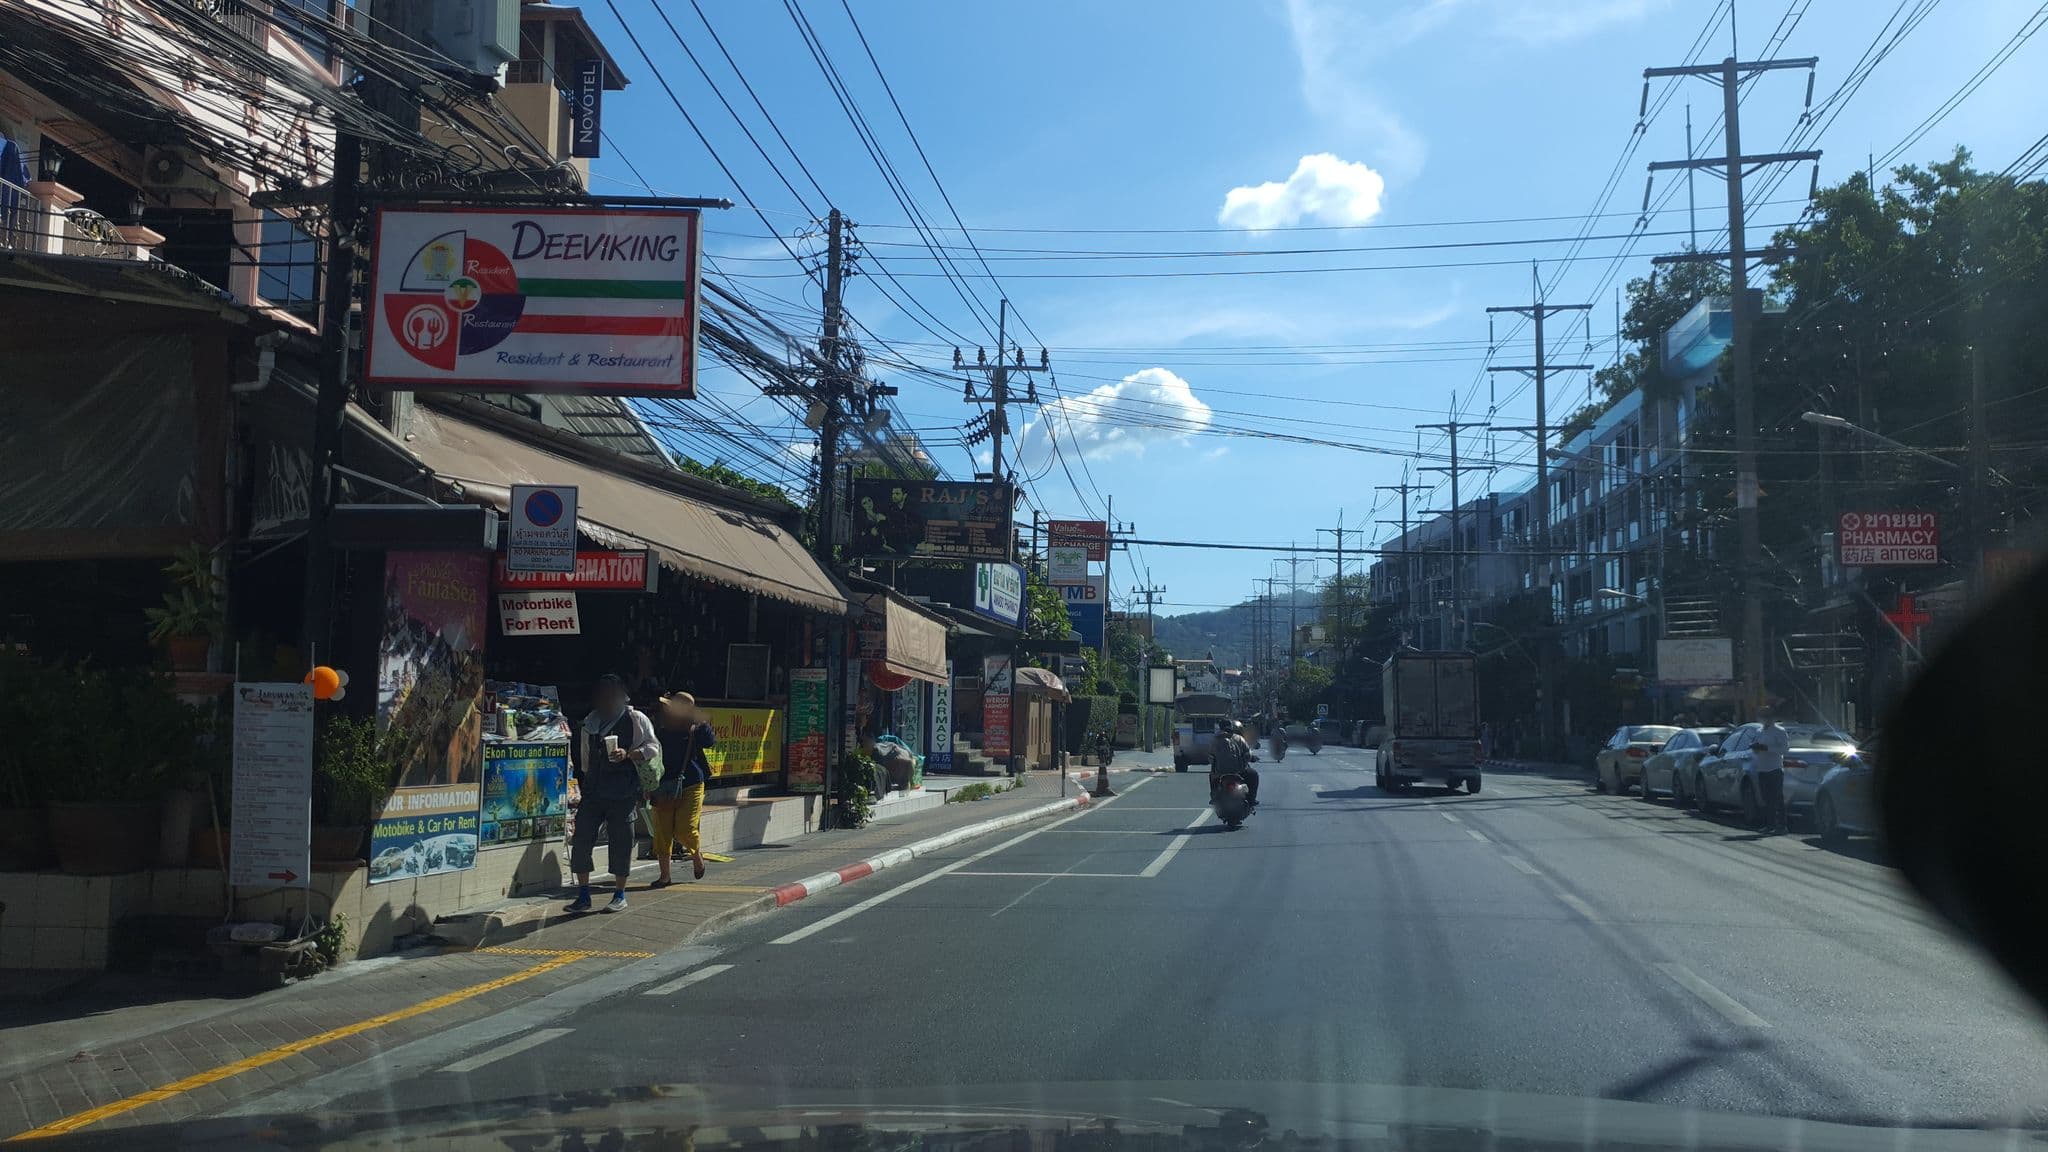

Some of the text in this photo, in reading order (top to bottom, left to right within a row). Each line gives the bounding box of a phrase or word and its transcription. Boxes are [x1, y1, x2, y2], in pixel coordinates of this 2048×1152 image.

[579, 64, 596, 143] NOVOTEL
[511, 220, 680, 263] DEEVIKING
[466, 259, 510, 275] Resident
[463, 313, 516, 329] Restaurant
[497, 351, 673, 369] Resident & Restaurant
[1863, 513, 1935, 529] ขายยา
[1842, 530, 1934, 545] PHARMACY
[1843, 547, 1935, 562] 药店 аптека
[502, 598, 573, 611] Motorbike
[505, 617, 575, 631] For Rent
[485, 744, 567, 759] Ekon Tour and Travel
[408, 790, 478, 810] INFORMATION
[373, 815, 476, 839] Motobike & Car For Rent
